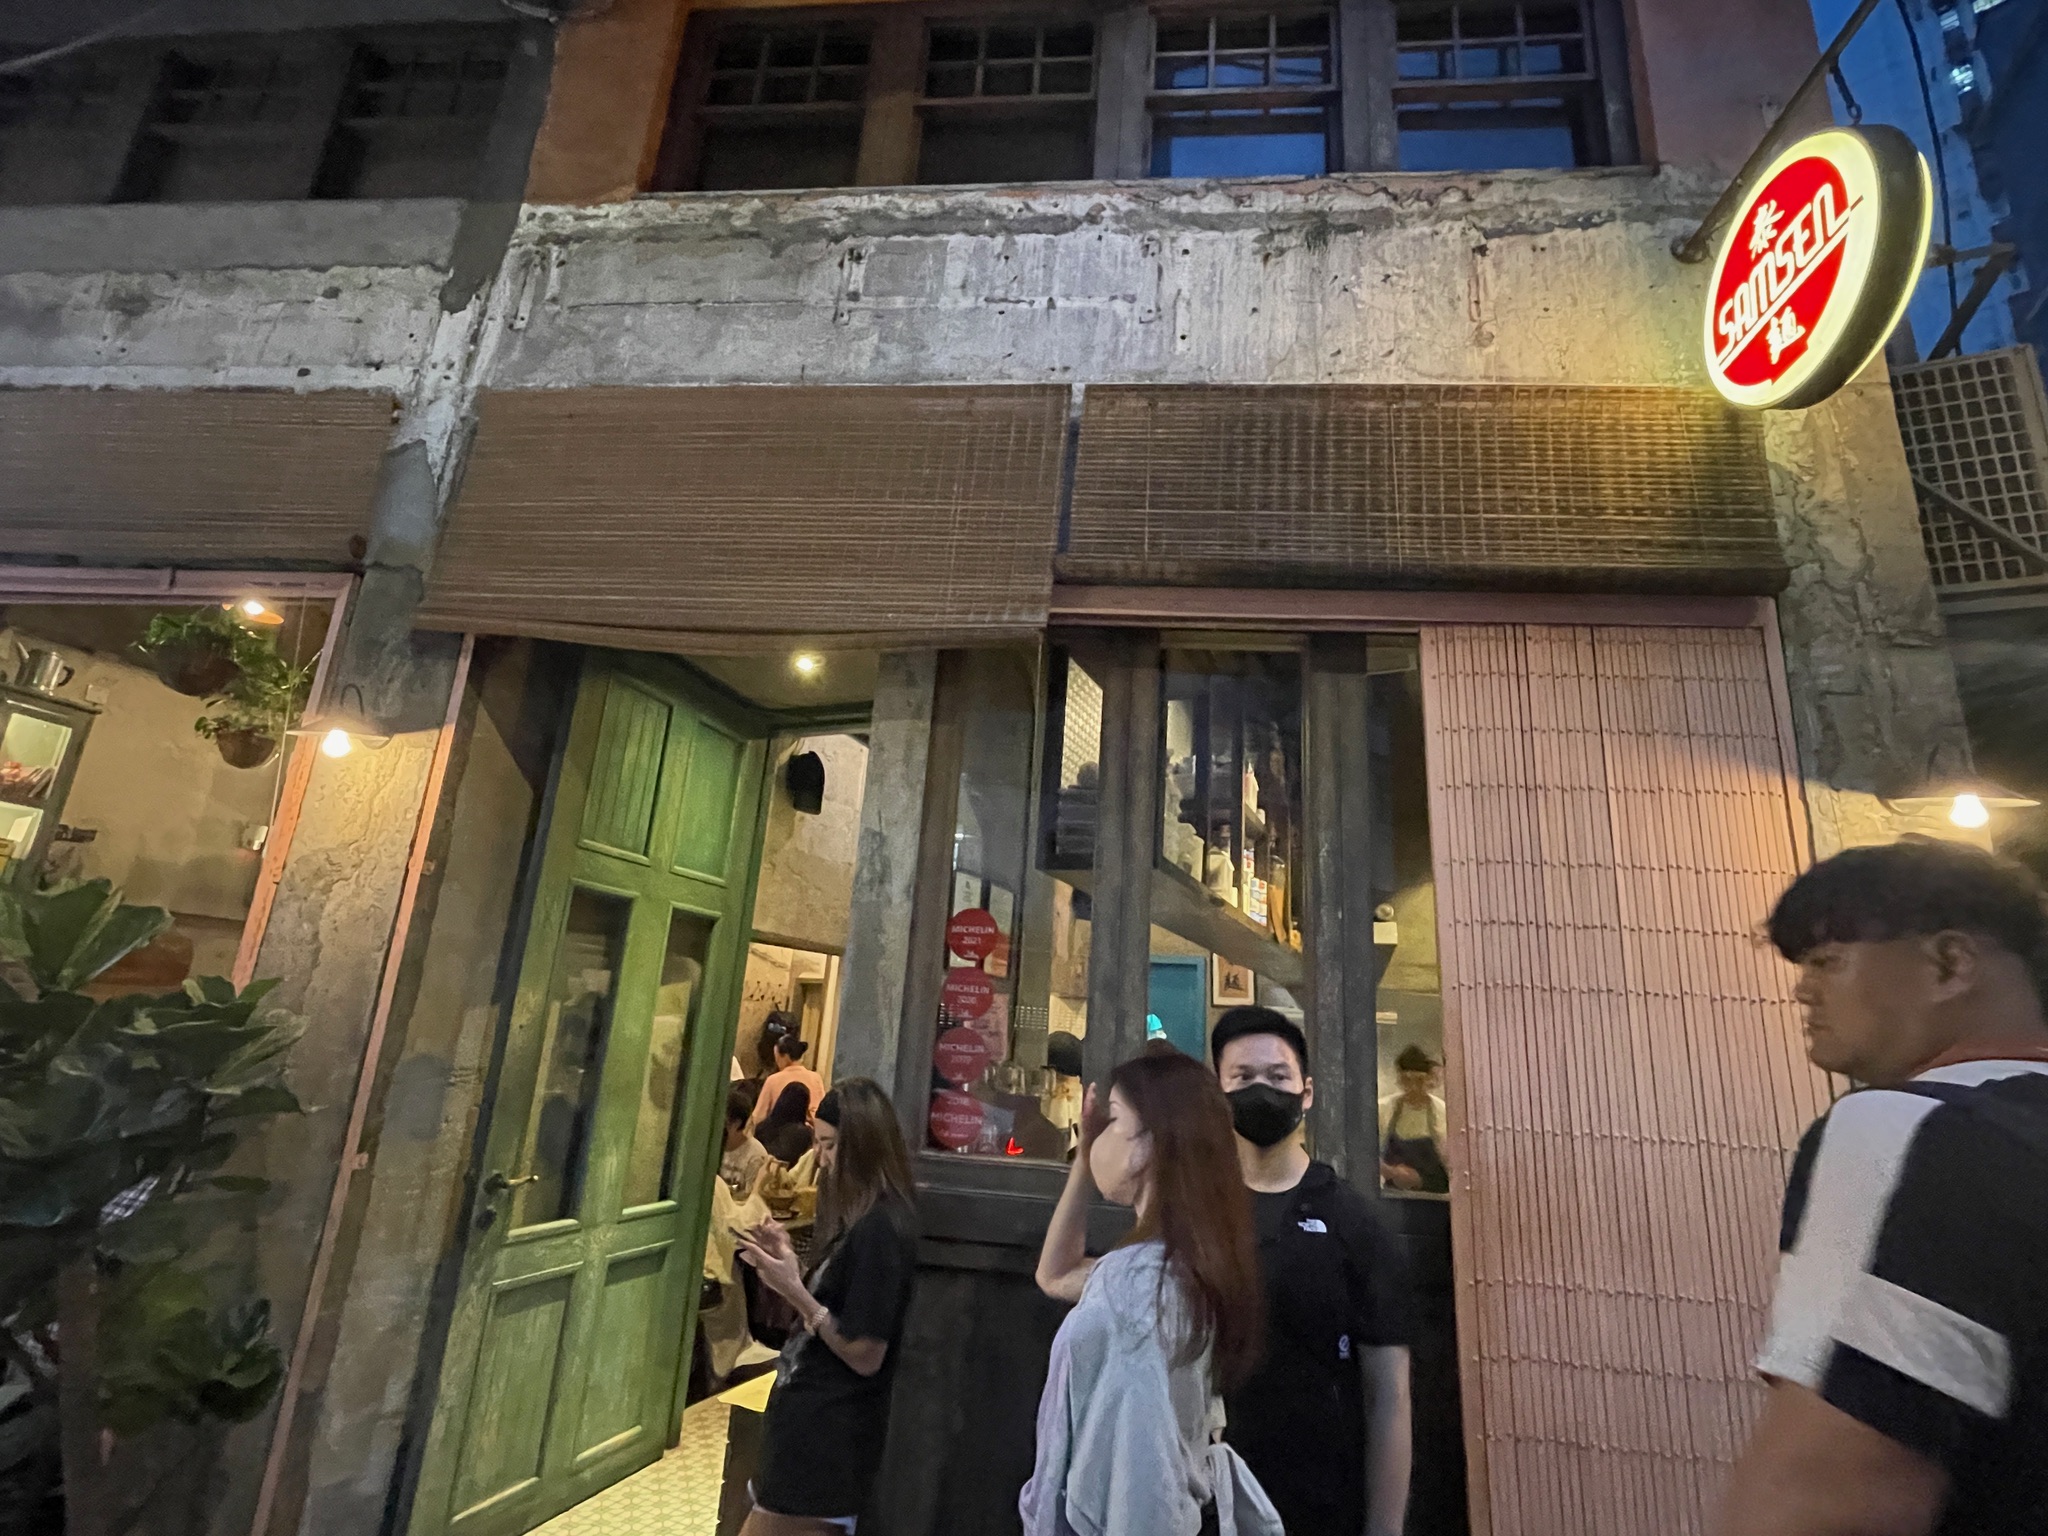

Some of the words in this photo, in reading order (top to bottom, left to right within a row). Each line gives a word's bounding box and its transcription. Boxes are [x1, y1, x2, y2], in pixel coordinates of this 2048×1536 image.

[1749, 199, 1784, 261] 泰
[1717, 183, 1852, 352] SAMSEN
[952, 925, 995, 934] MICHELIN
[961, 936, 982, 945] 2021
[946, 983, 990, 994] MICHELIN
[939, 1042, 985, 1053] MICHELIN
[931, 1111, 983, 1125] MICHELIN
